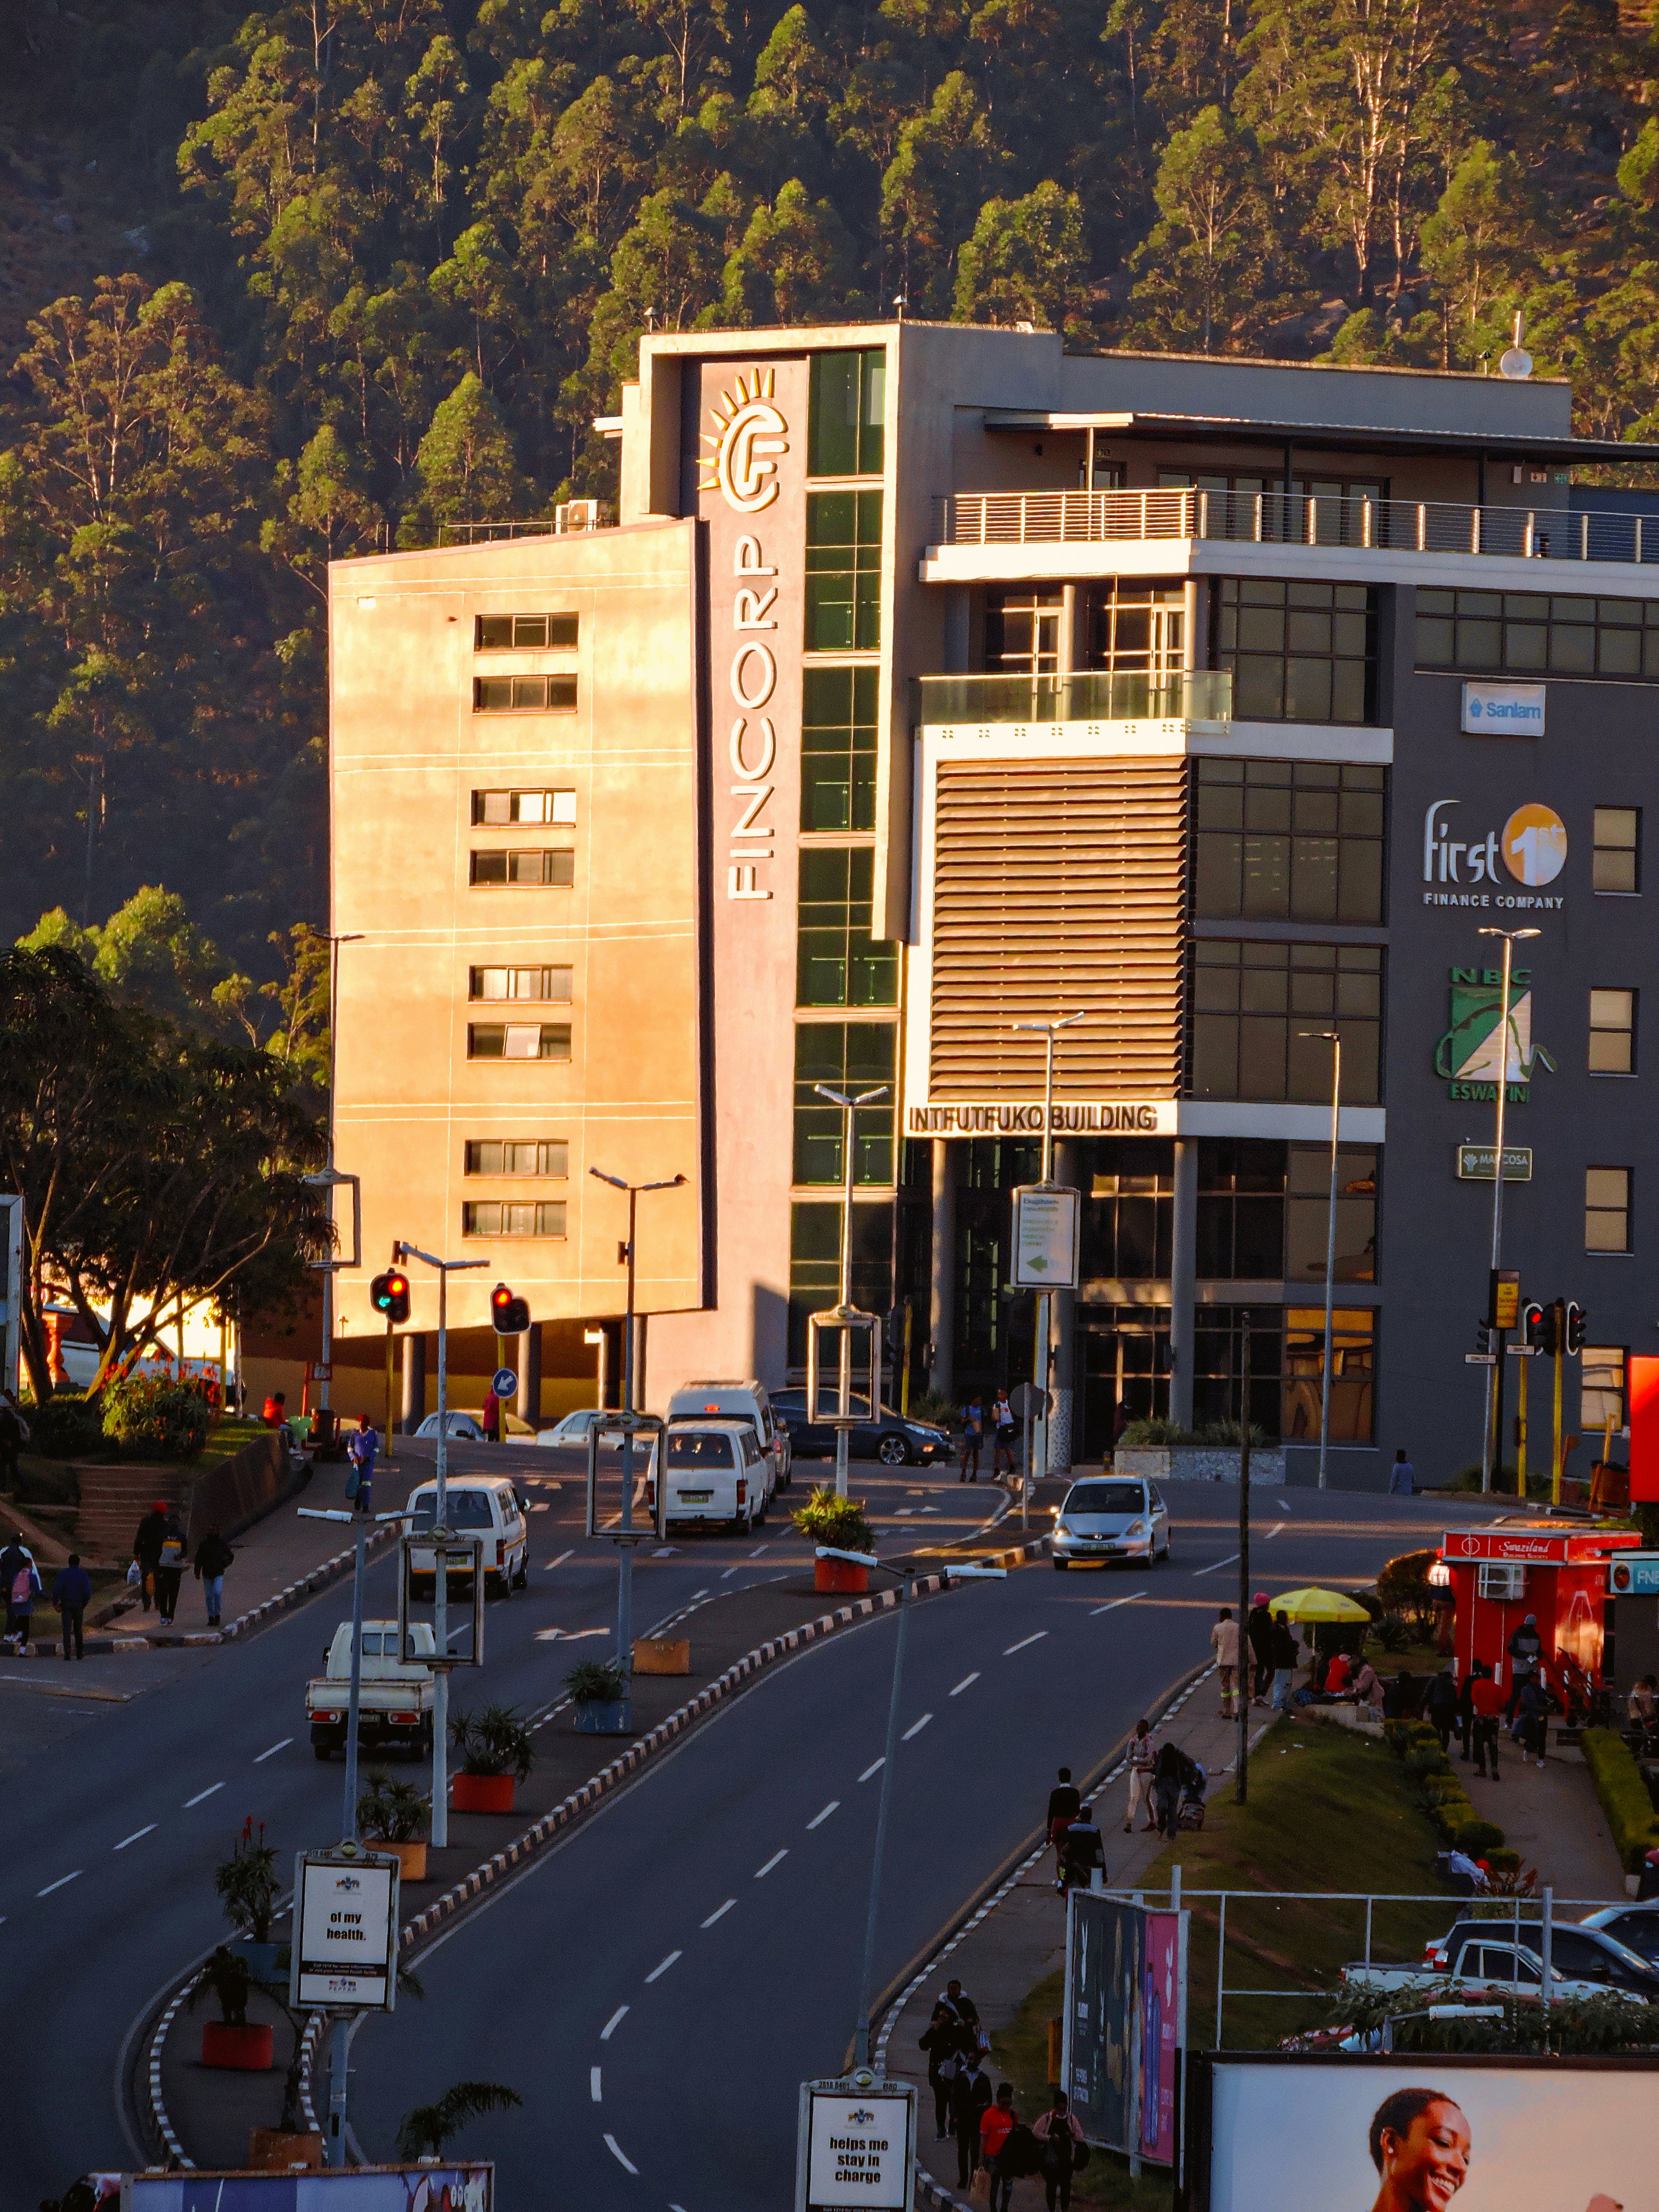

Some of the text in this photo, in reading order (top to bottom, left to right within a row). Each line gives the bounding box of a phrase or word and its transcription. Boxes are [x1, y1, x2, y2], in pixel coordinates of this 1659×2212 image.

[727, 534, 778, 901] FINCORP
[1487, 702, 1541, 719] Sanlam
[1423, 799, 1502, 884] first
[1423, 892, 1564, 909] FINANCE COMPANY
[1450, 967, 1532, 985] NBC
[1450, 1083, 1530, 1103] ESWAINI
[910, 1105, 1158, 1131] INTFUTFUKO BUILDING
[1479, 1154, 1528, 1165] MACOSA
[1499, 1538, 1552, 1553] Swaziland
[330, 1911, 362, 1924] of my
[326, 1928, 367, 1941] health.
[830, 2137, 889, 2151] helps me
[837, 2154, 880, 2167] stay in
[835, 2169, 881, 2184] charge
